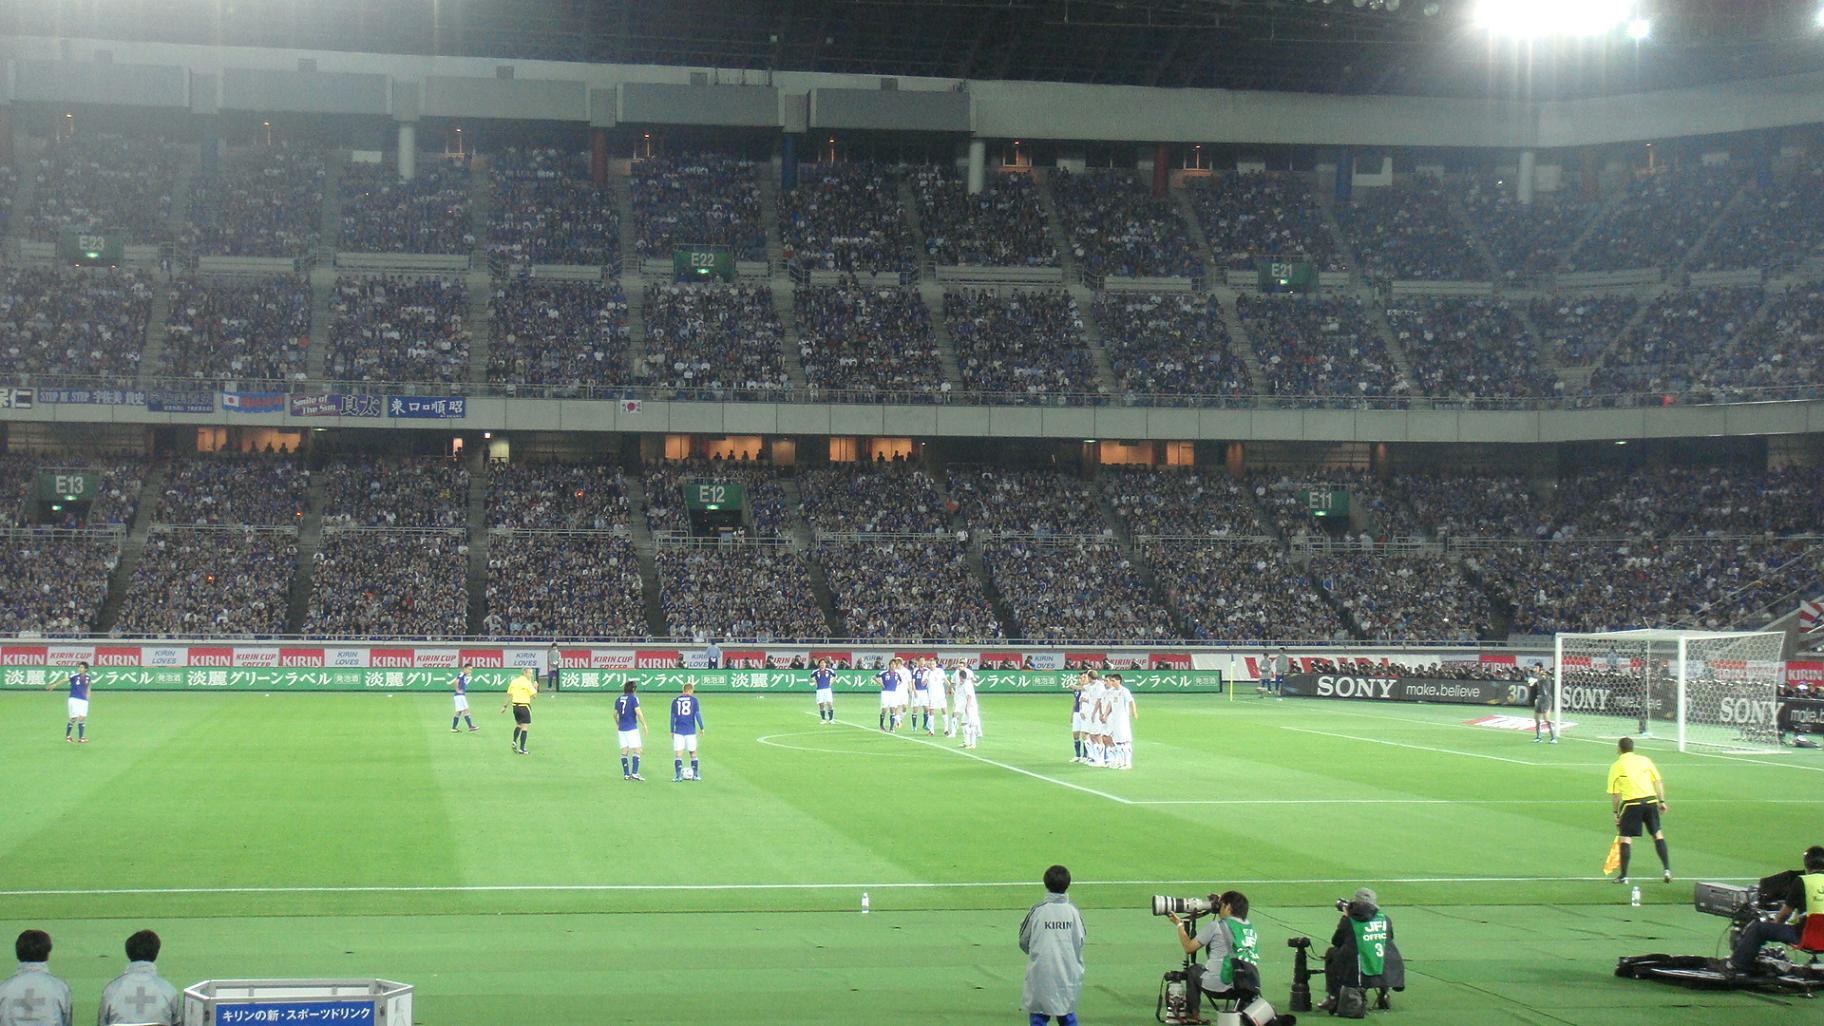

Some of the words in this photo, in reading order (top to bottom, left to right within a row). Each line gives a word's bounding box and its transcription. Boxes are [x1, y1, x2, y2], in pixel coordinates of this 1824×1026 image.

[691, 253, 714, 266] E22
[1271, 263, 1292, 277] E21
[56, 475, 83, 494] E13
[700, 485, 725, 502] E12
[1310, 491, 1331, 509] E11
[3, 654, 45, 666] KIRIN
[50, 652, 73, 660] KIRIN
[74, 652, 92, 660] CUP
[95, 655, 140, 666] KIRIN
[151, 657, 177, 665] LOVES
[190, 655, 232, 666] KIRIN
[236, 653, 260, 661] KIRIN
[283, 656, 322, 667] KIRIN
[335, 658, 360, 666] LOVES
[372, 656, 414, 667] KIRIN
[462, 656, 501, 667] KIRIN
[593, 655, 616, 663] KIRIN
[616, 655, 633, 663] CUP
[559, 657, 589, 668] IRIN
[638, 658, 678, 668] KIRIN
[187, 670, 332, 686] 淡麗グリーンラベル
[561, 672, 700, 688] 淡麗グリーンラベル
[1787, 669, 1823, 680] KIRIN
[1317, 676, 1397, 698] SONY
[1507, 685, 1528, 701] 3D
[1561, 686, 1610, 709] SONY
[620, 700, 627, 714] 7
[677, 700, 691, 716] 18
[1720, 697, 1784, 725] SONY
[1044, 921, 1072, 930] KIRIN
[1362, 933, 1388, 941] OFFIC
[1375, 943, 1384, 957] 3
[222, 1007, 371, 1022] キリンの新・スポーツドリンク
